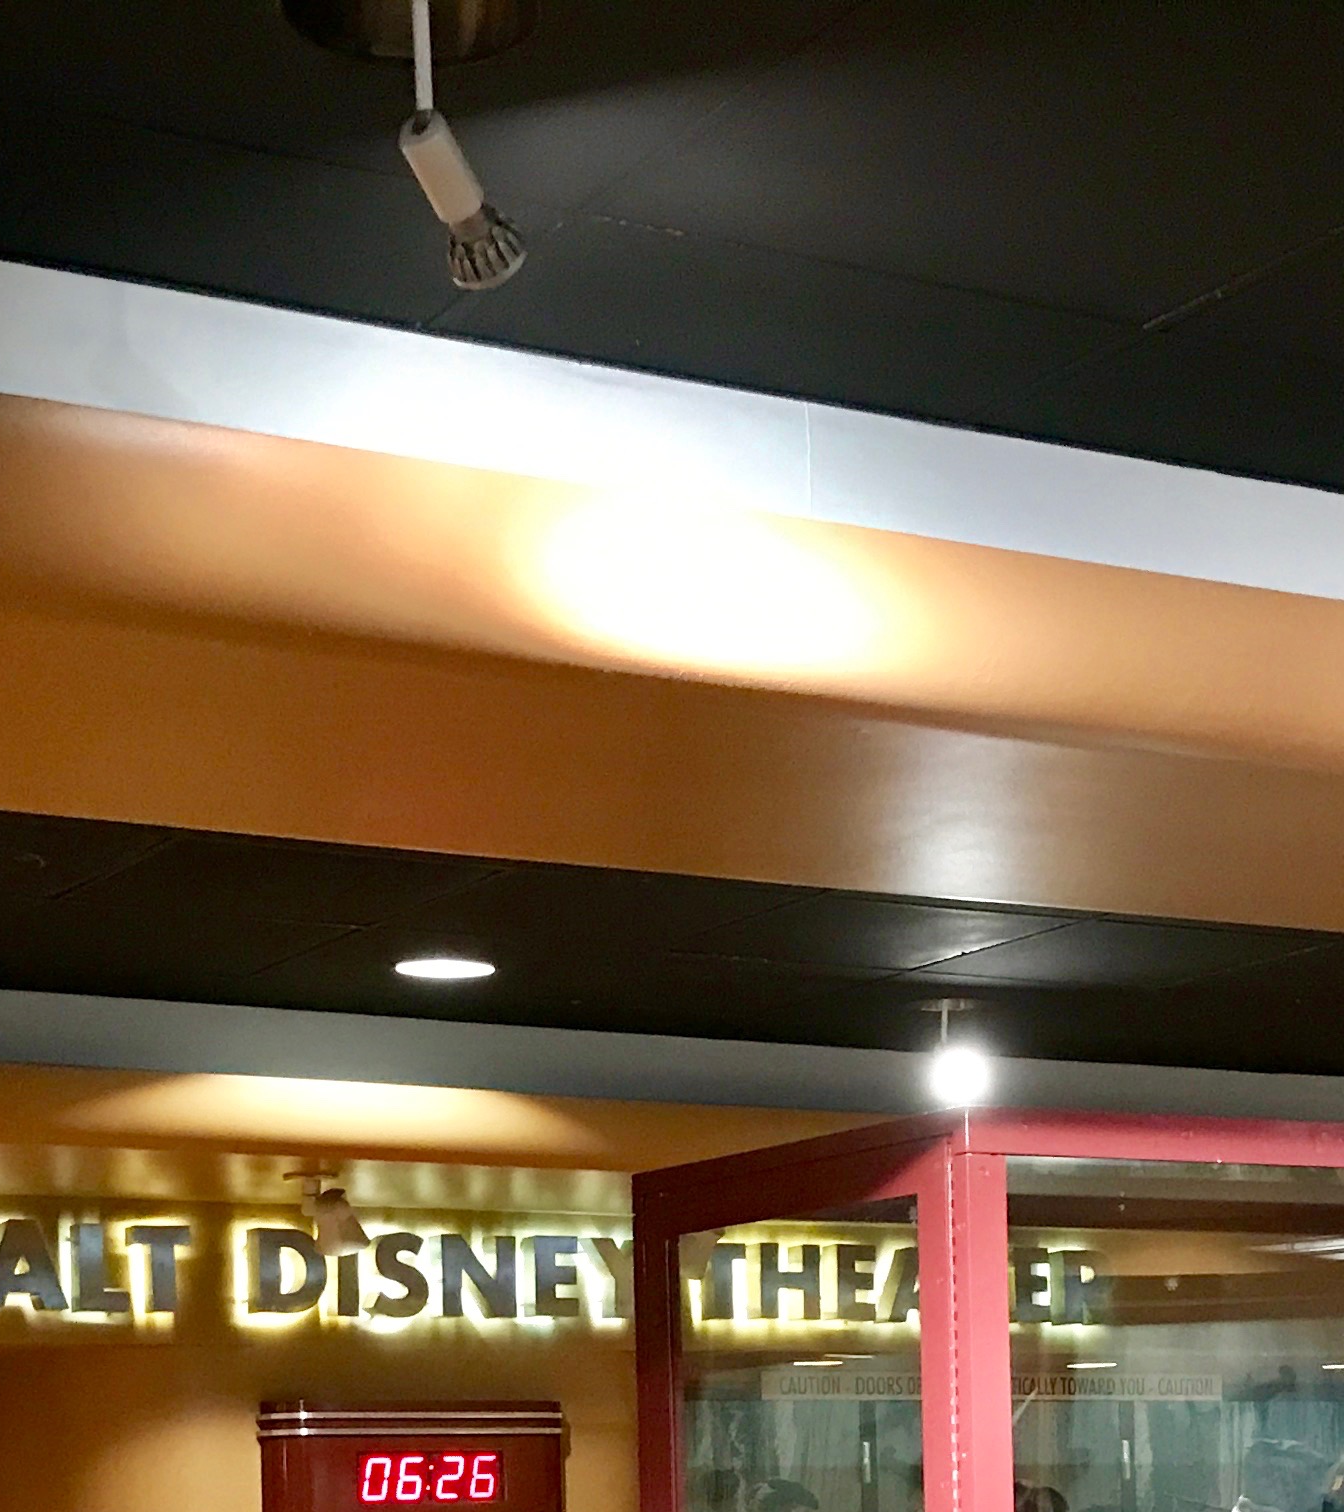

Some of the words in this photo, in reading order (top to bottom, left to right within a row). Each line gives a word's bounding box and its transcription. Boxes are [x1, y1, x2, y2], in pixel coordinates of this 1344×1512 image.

[246, 1227, 634, 1318] DISNEY
[702, 1241, 1110, 1326] THEAER
[779, 1375, 841, 1396] CAUTION
[855, 1376, 904, 1396] DOORS
[1060, 1375, 1116, 1396] TOWARD
[1119, 1376, 1145, 1396] YOU
[1157, 1376, 1215, 1396] CAUTION
[361, 1454, 498, 1502] 06:26
